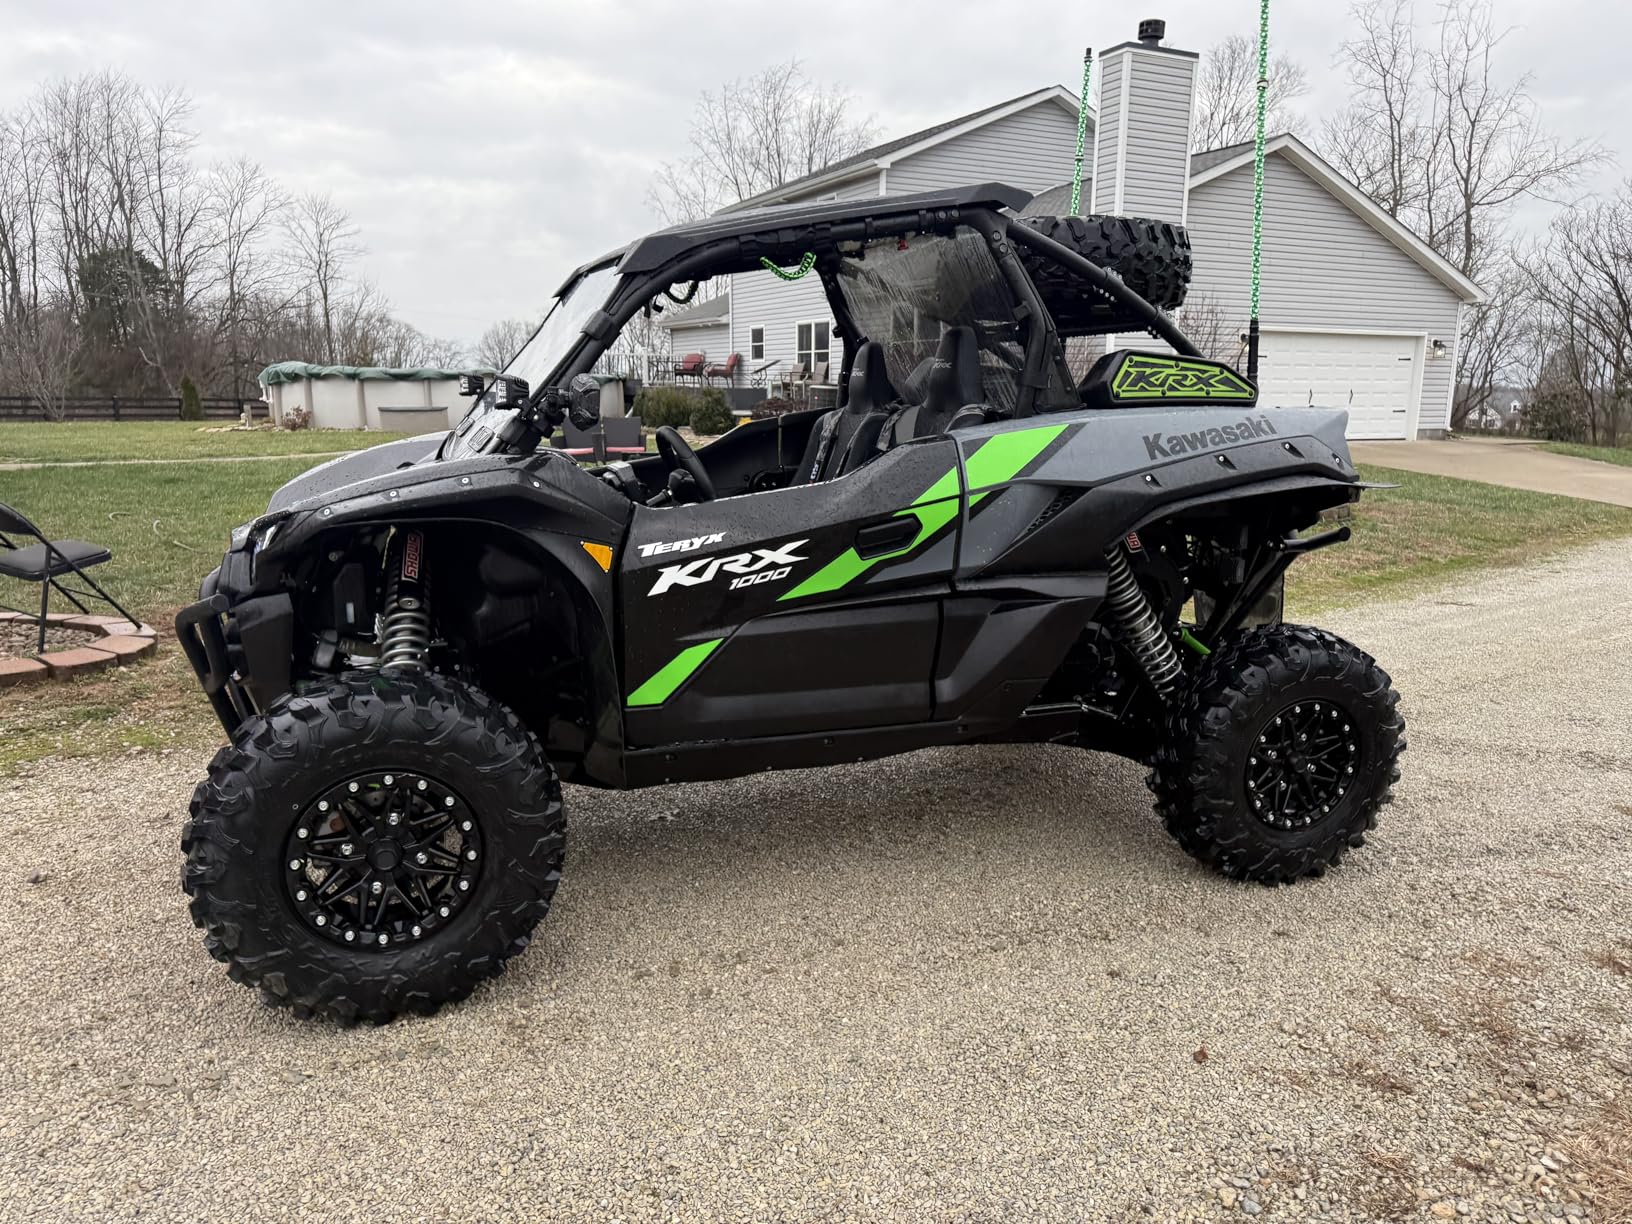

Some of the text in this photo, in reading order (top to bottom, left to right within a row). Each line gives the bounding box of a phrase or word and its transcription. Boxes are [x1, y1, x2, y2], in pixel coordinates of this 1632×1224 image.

[1125, 367, 1229, 390] KRX
[1142, 415, 1278, 460] Kawasaki
[647, 538, 810, 597] KRX
[729, 566, 793, 591] 1000
